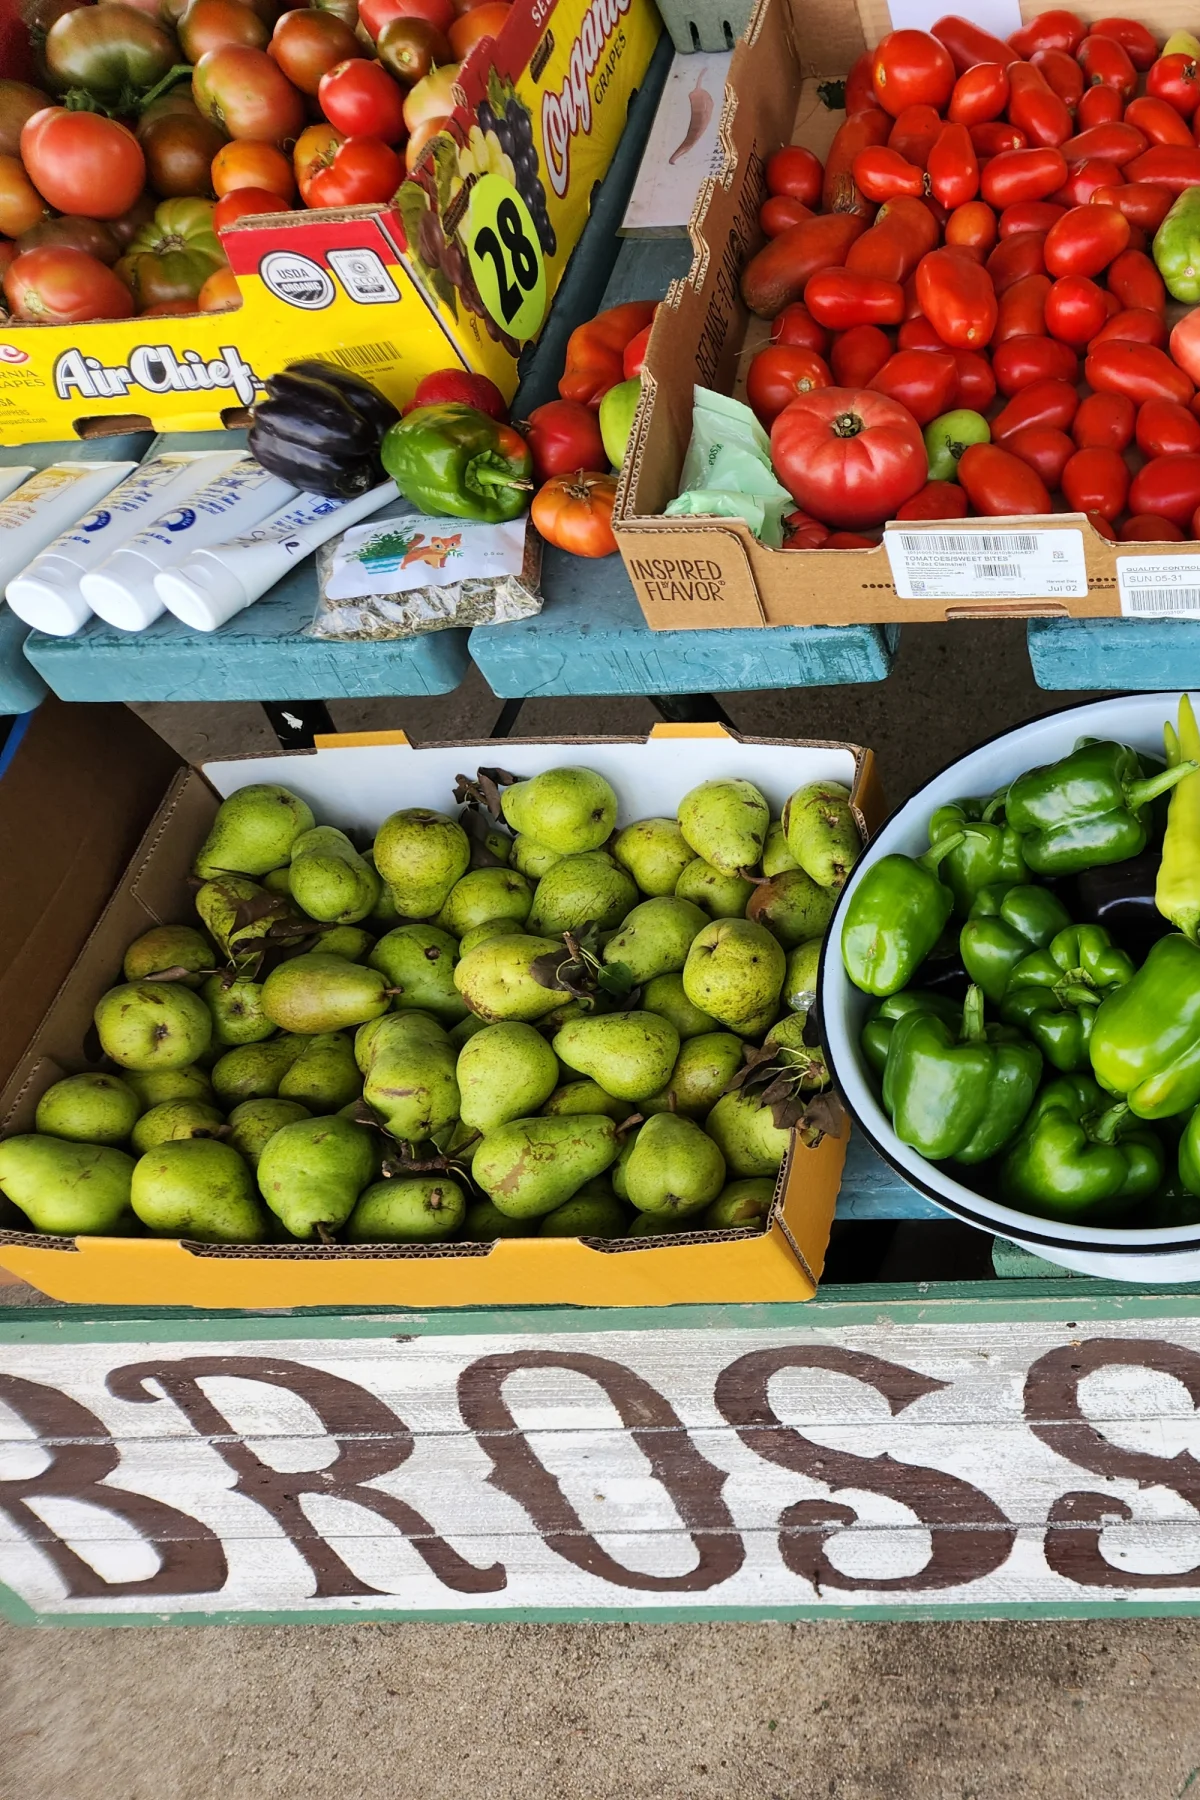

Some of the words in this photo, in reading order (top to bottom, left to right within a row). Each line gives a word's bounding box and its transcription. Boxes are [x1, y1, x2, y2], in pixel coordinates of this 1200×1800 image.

[594, 29, 627, 104] GRAPES
[473, 197, 539, 325] 28
[276, 268, 310, 280] USDA
[281, 281, 323, 292] ORGANIC
[695, 290, 729, 389] BECAUSE
[629, 559, 722, 580] INSPIRED
[1129, 575, 1152, 583] SUN
[1155, 574, 1183, 582] 05-31
[1048, 584, 1062, 592] Jul
